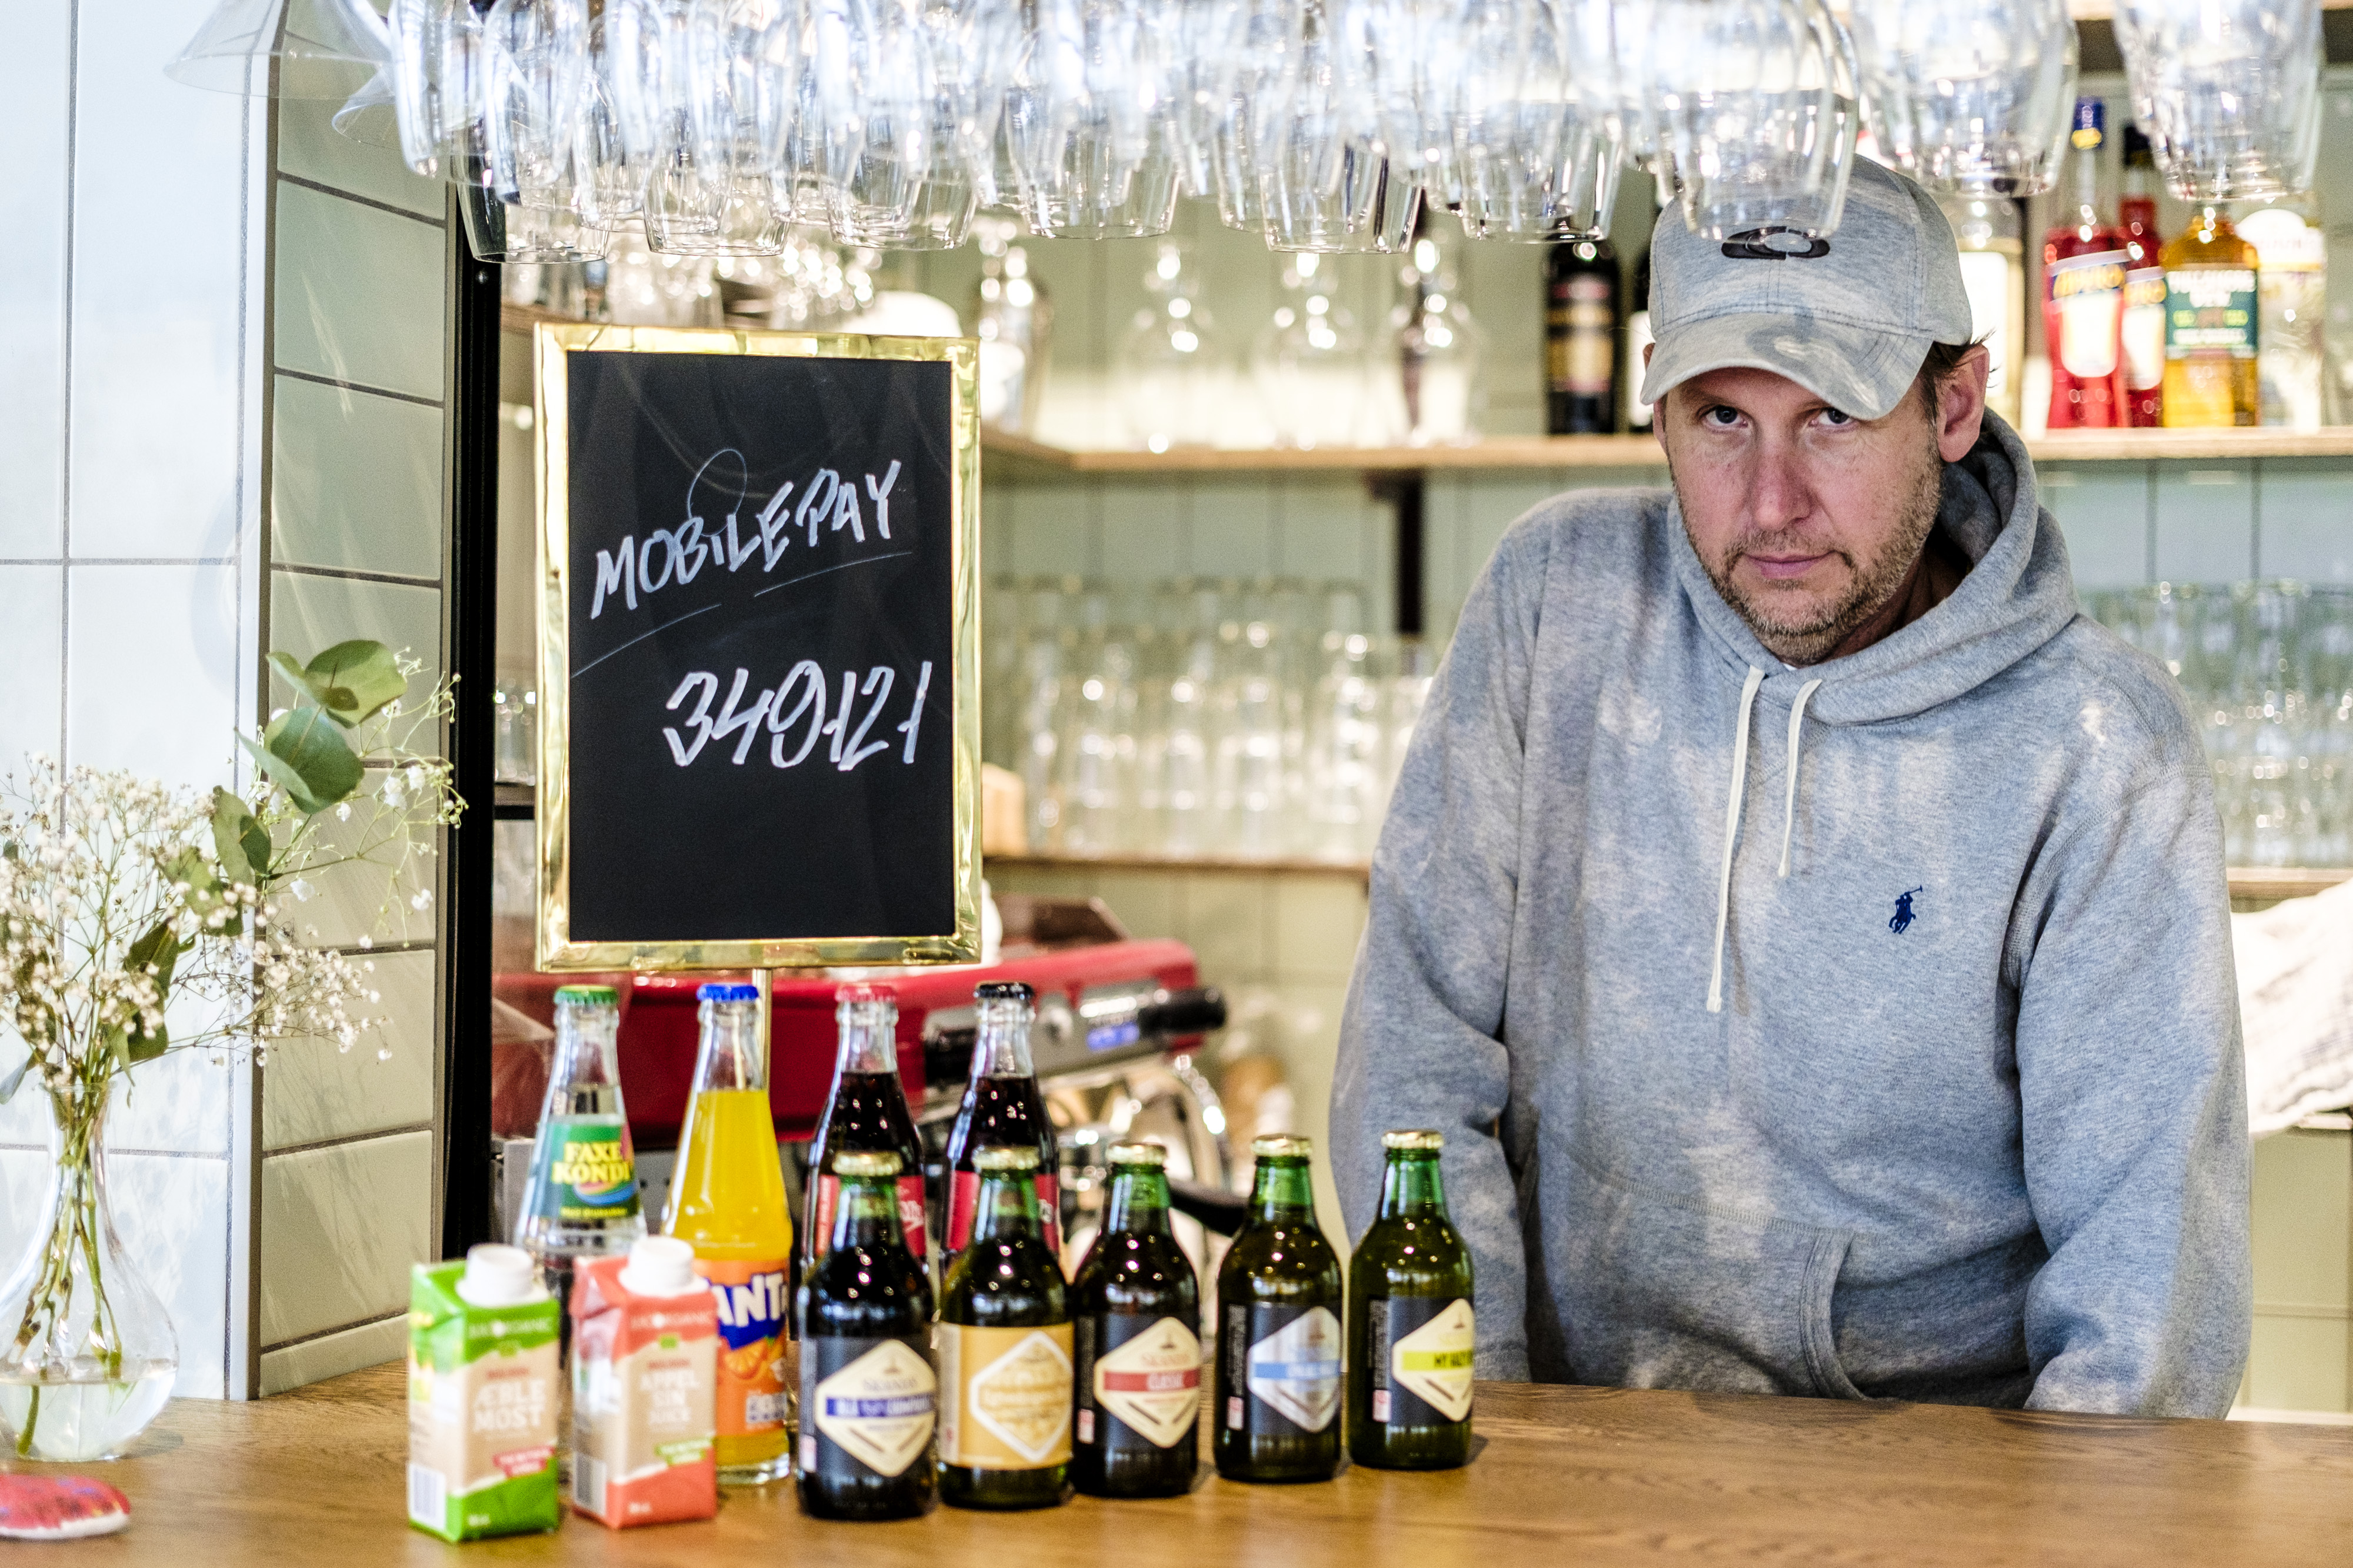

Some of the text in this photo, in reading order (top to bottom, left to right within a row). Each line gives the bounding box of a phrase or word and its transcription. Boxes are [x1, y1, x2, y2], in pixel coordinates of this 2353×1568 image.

[662, 660, 933, 772] 349121
[564, 1141, 622, 1163] FAXE
[552, 1160, 631, 1185] KONDI
[473, 1403, 546, 1433] MOST
